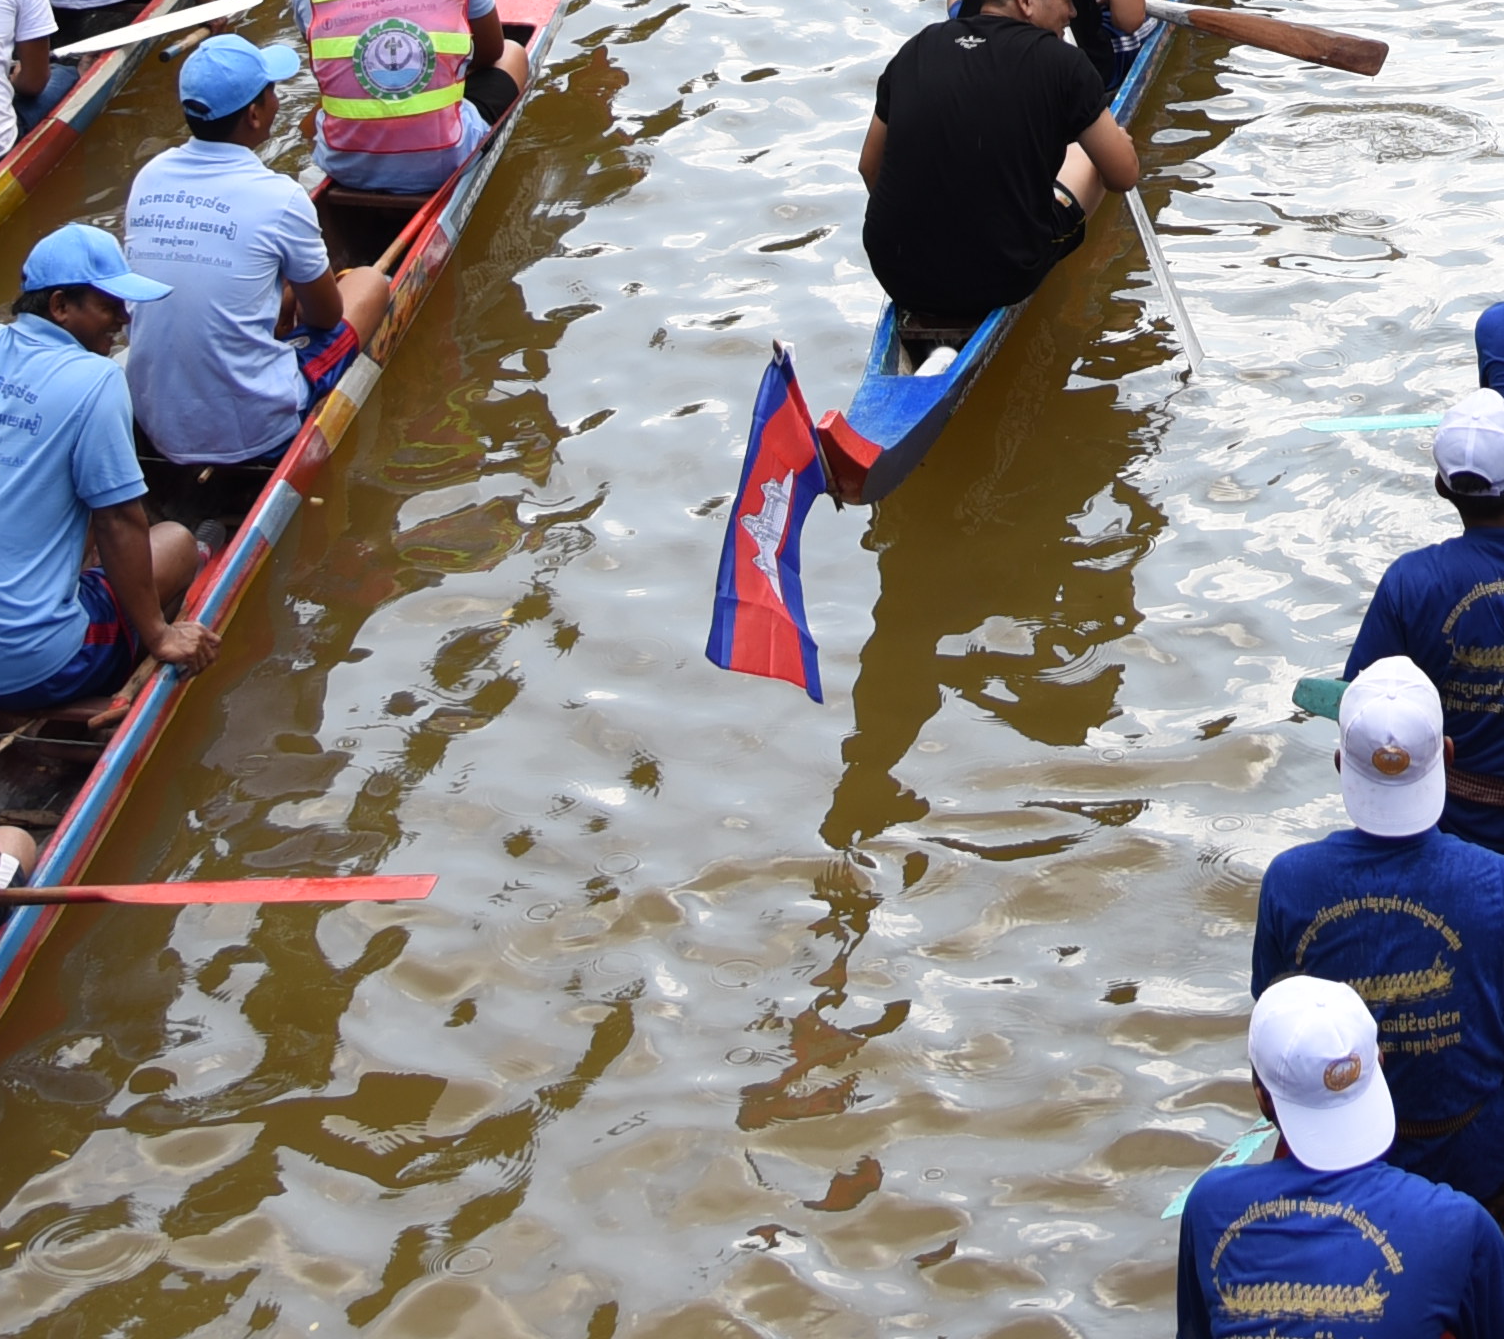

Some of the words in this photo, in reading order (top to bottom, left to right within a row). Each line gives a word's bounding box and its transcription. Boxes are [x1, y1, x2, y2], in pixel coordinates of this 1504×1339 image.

[134, 249, 164, 259] University
[166, 251, 173, 259] of
[214, 257, 232, 268] Asia
